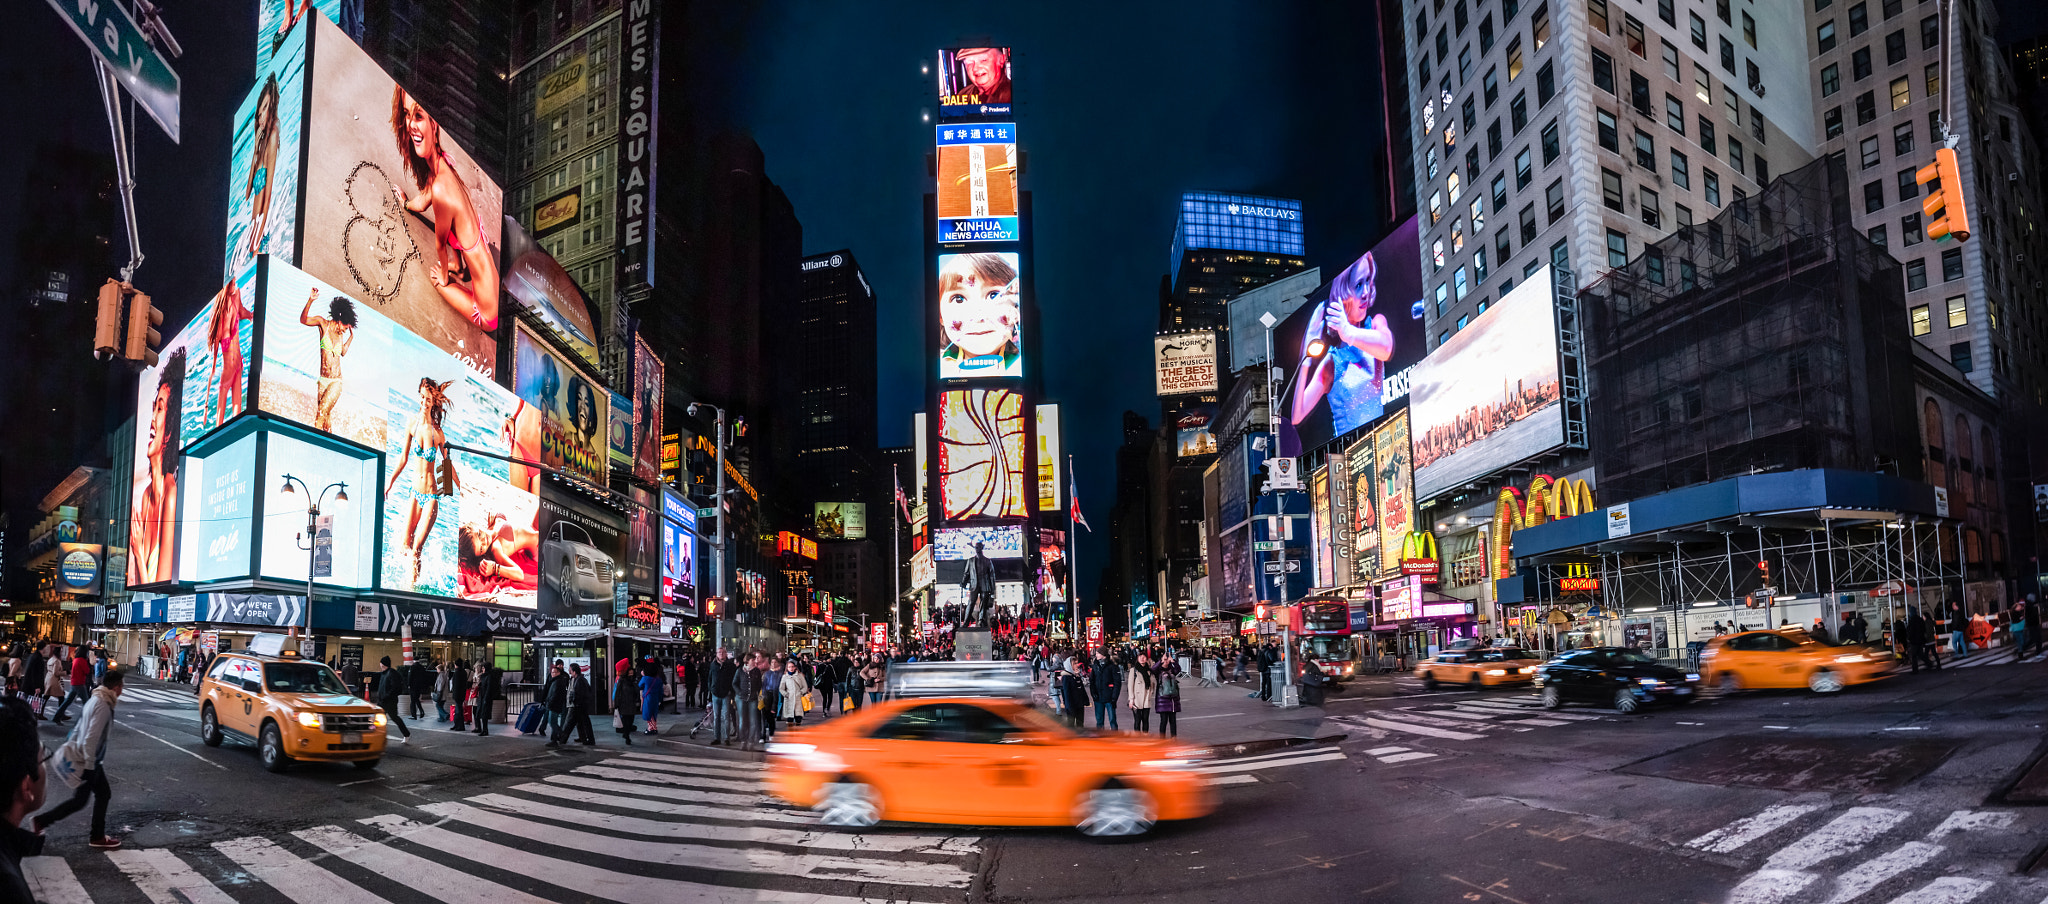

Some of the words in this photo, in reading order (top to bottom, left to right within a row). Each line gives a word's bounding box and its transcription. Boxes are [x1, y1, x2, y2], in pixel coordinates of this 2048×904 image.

[629, 0, 649, 71] MES
[543, 64, 581, 99] Z100
[943, 94, 968, 106] DALE
[970, 93, 982, 105] N.
[943, 128, 1008, 140] 新华通讯社
[625, 86, 649, 246] SQUARE
[1242, 205, 1295, 220] BARCLAYS
[945, 231, 972, 240] NEWS
[973, 230, 1013, 239] AGENCY
[955, 221, 1002, 232] XINHUA
[625, 262, 641, 273] NYC
[801, 259, 829, 271] Allianz
[525, 261, 554, 292] IMPORTED
[554, 289, 568, 306] FROM
[963, 358, 999, 366] SAMSUNG
[1180, 358, 1213, 367] MUSICAL
[1185, 365, 1213, 376] BEST
[1161, 374, 1200, 385] MUSICAL
[1201, 373, 1214, 381] OF
[1381, 367, 1411, 405] JERSE
[611, 416, 626, 450] Q
[662, 433, 679, 442] UTERS
[542, 427, 597, 478] OTOWN
[215, 472, 230, 489] VISIT
[230, 469, 239, 483] US
[208, 489, 225, 506] INSIDE
[226, 485, 235, 500] ON
[236, 480, 247, 496] THE
[223, 499, 238, 516] LEVEL
[1334, 462, 1349, 558] PALACE
[1385, 492, 1404, 515] NICE
[542, 501, 569, 518] CHRYSLER
[581, 517, 601, 530] MOTOWN
[601, 525, 618, 537] EDITION
[1384, 507, 1407, 530] WORK
[208, 523, 239, 558] aerie
[1356, 528, 1378, 552] Annie
[247, 601, 273, 610] WE'RE
[247, 610, 268, 618] OPEN
[413, 613, 430, 621] WE'RE
[558, 614, 599, 627] snackBOX
[874, 624, 885, 644] tkts
